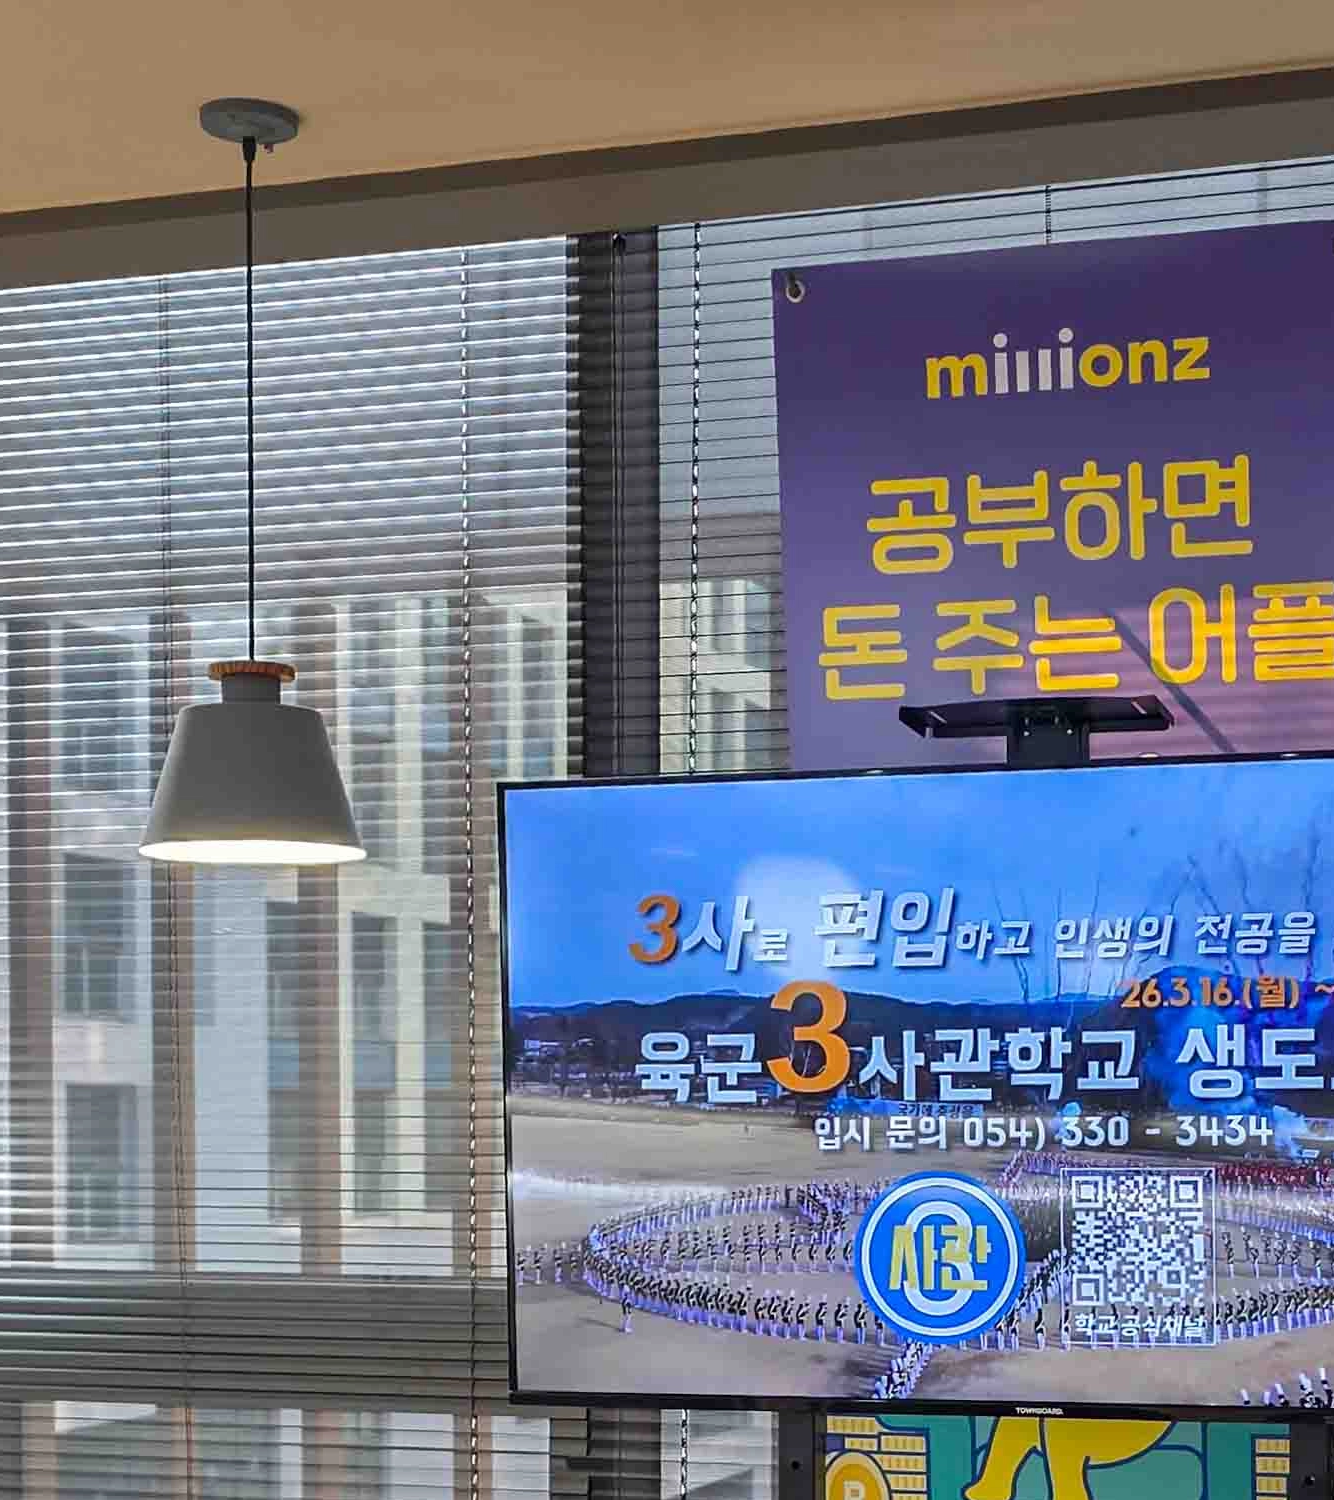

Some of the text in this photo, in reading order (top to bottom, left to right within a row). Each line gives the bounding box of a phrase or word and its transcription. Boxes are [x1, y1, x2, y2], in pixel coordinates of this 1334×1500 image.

[866, 454, 1254, 576] 공부하면
[818, 603, 908, 701] 돈
[932, 595, 1122, 696] 주는
[628, 892, 789, 971] 3사로
[813, 886, 1034, 969] 편입하고
[1054, 911, 1175, 959] 인생의
[1194, 910, 1317, 956] 전공을
[635, 980, 1140, 1103] 육군3사관학교
[814, 1115, 871, 1152] 입시
[886, 1115, 947, 1152] 문의
[963, 1116, 1046, 1151] 054)
[1061, 1114, 1130, 1147] 330
[1175, 1113, 1274, 1147] 3434
